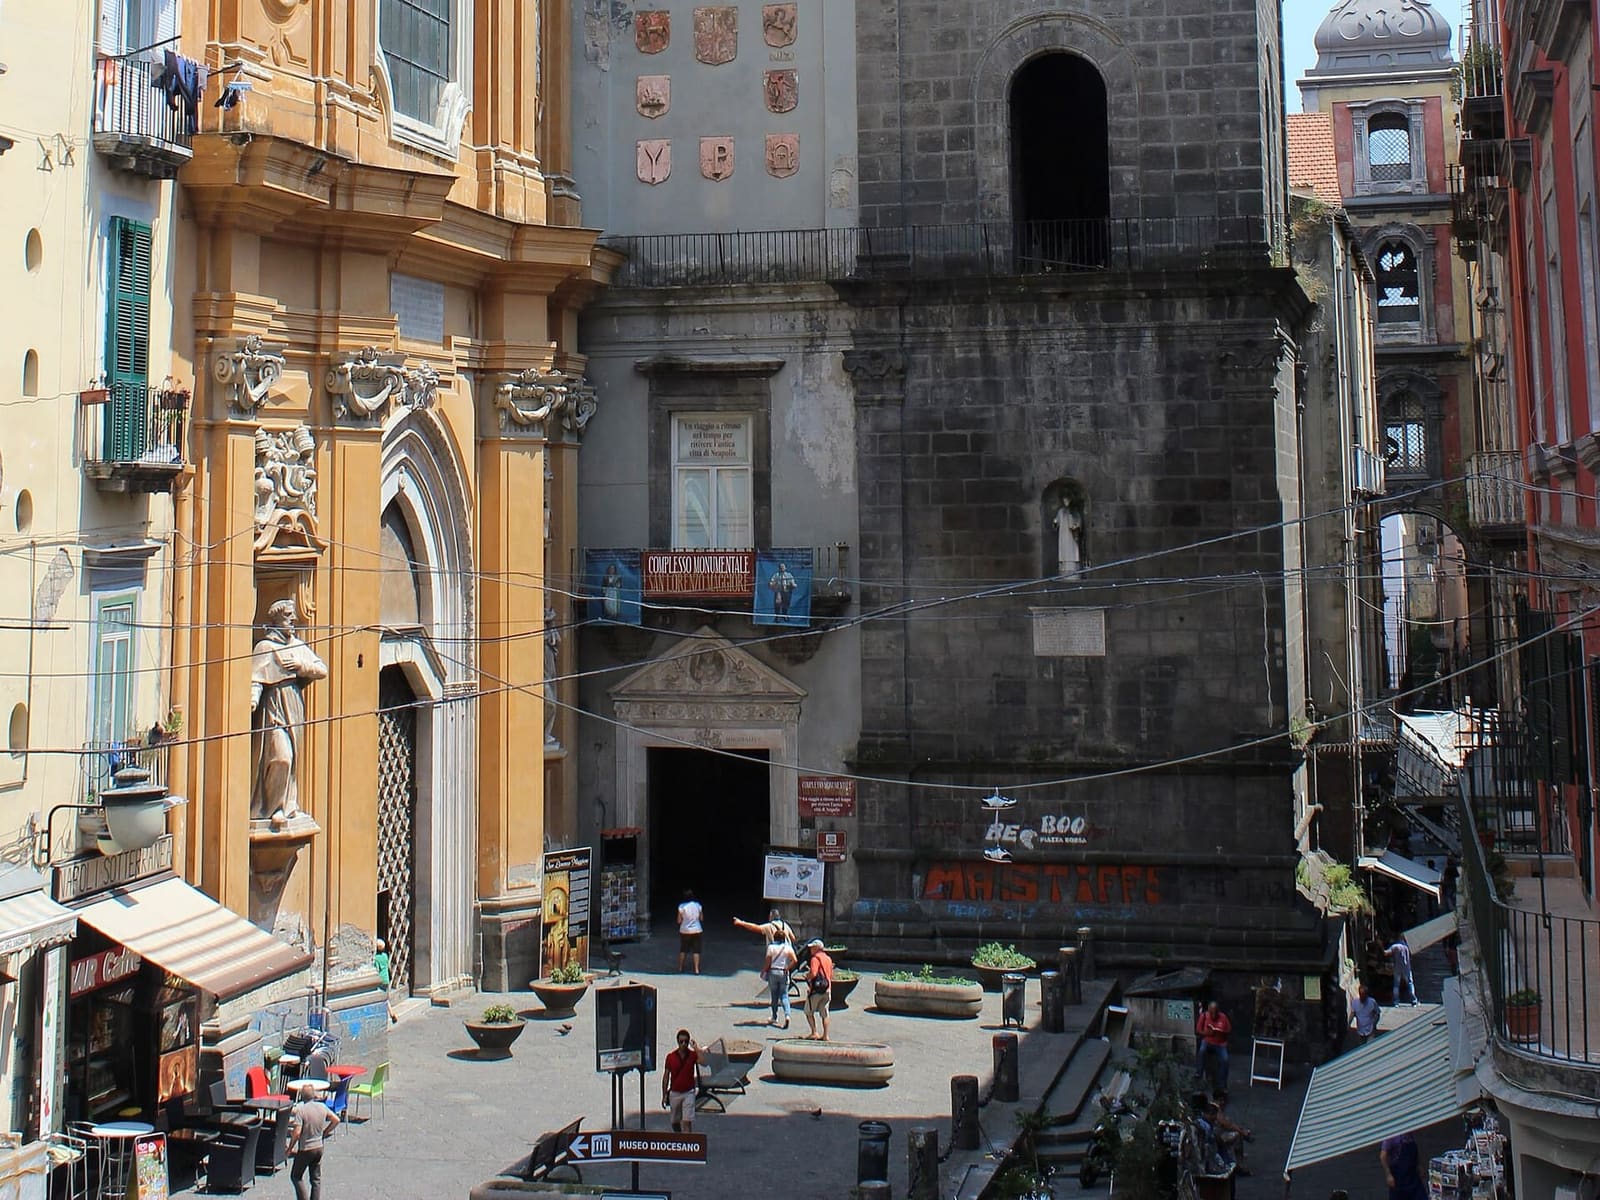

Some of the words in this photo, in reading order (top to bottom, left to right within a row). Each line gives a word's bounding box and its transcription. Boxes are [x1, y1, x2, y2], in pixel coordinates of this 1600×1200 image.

[648, 556, 692, 574] COMPLESSO
[693, 556, 751, 574] MONUMENTALE
[648, 573, 665, 593] SAN
[666, 573, 705, 593] LORENZO
[707, 573, 750, 593] MAGGIORE
[1041, 815, 1085, 834] BOO
[60, 860, 100, 899] NAPOLI
[619, 1140, 648, 1150] MUSEO
[650, 1141, 700, 1152] DIOCESANO
